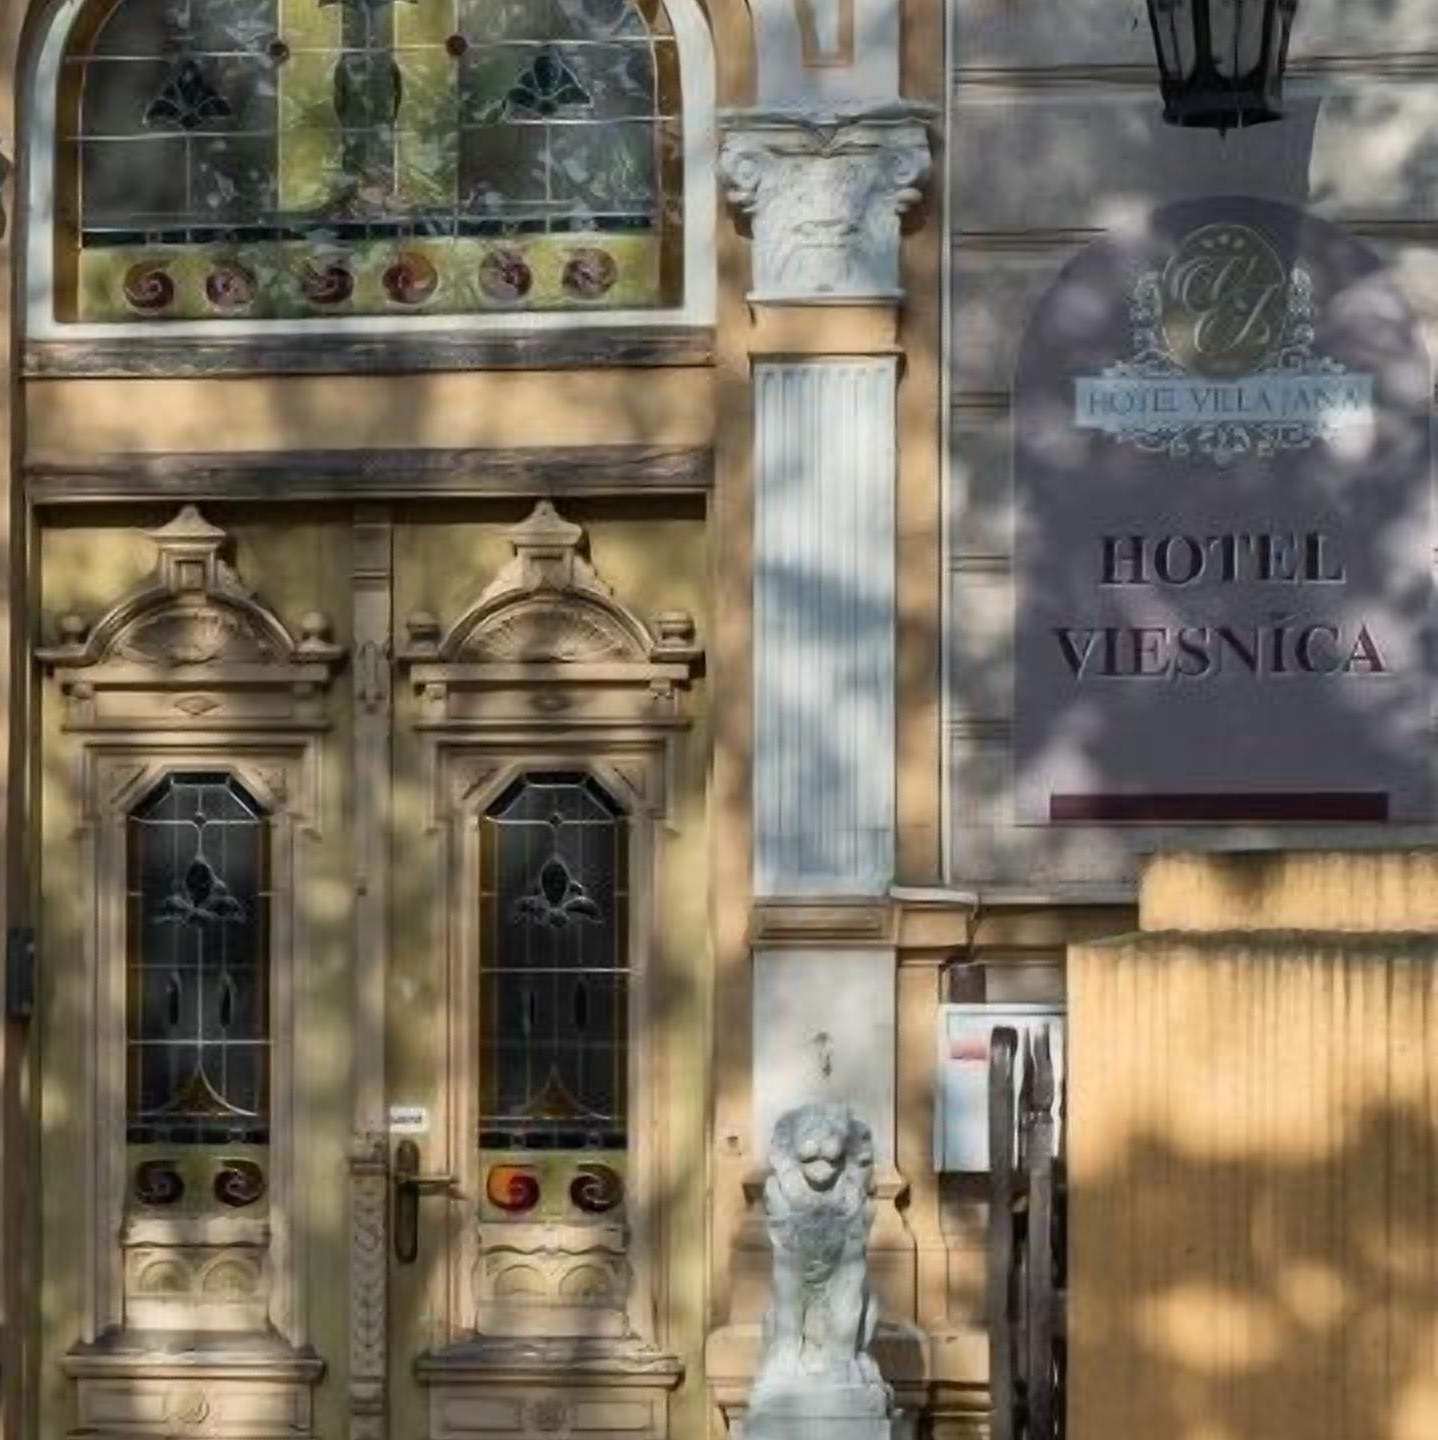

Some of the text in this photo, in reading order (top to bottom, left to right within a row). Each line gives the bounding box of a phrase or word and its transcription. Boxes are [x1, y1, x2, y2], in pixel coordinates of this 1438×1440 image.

[1089, 387, 1179, 416] HOTEL
[1189, 386, 1273, 413] VILLA
[1099, 532, 1346, 586] HOTEL
